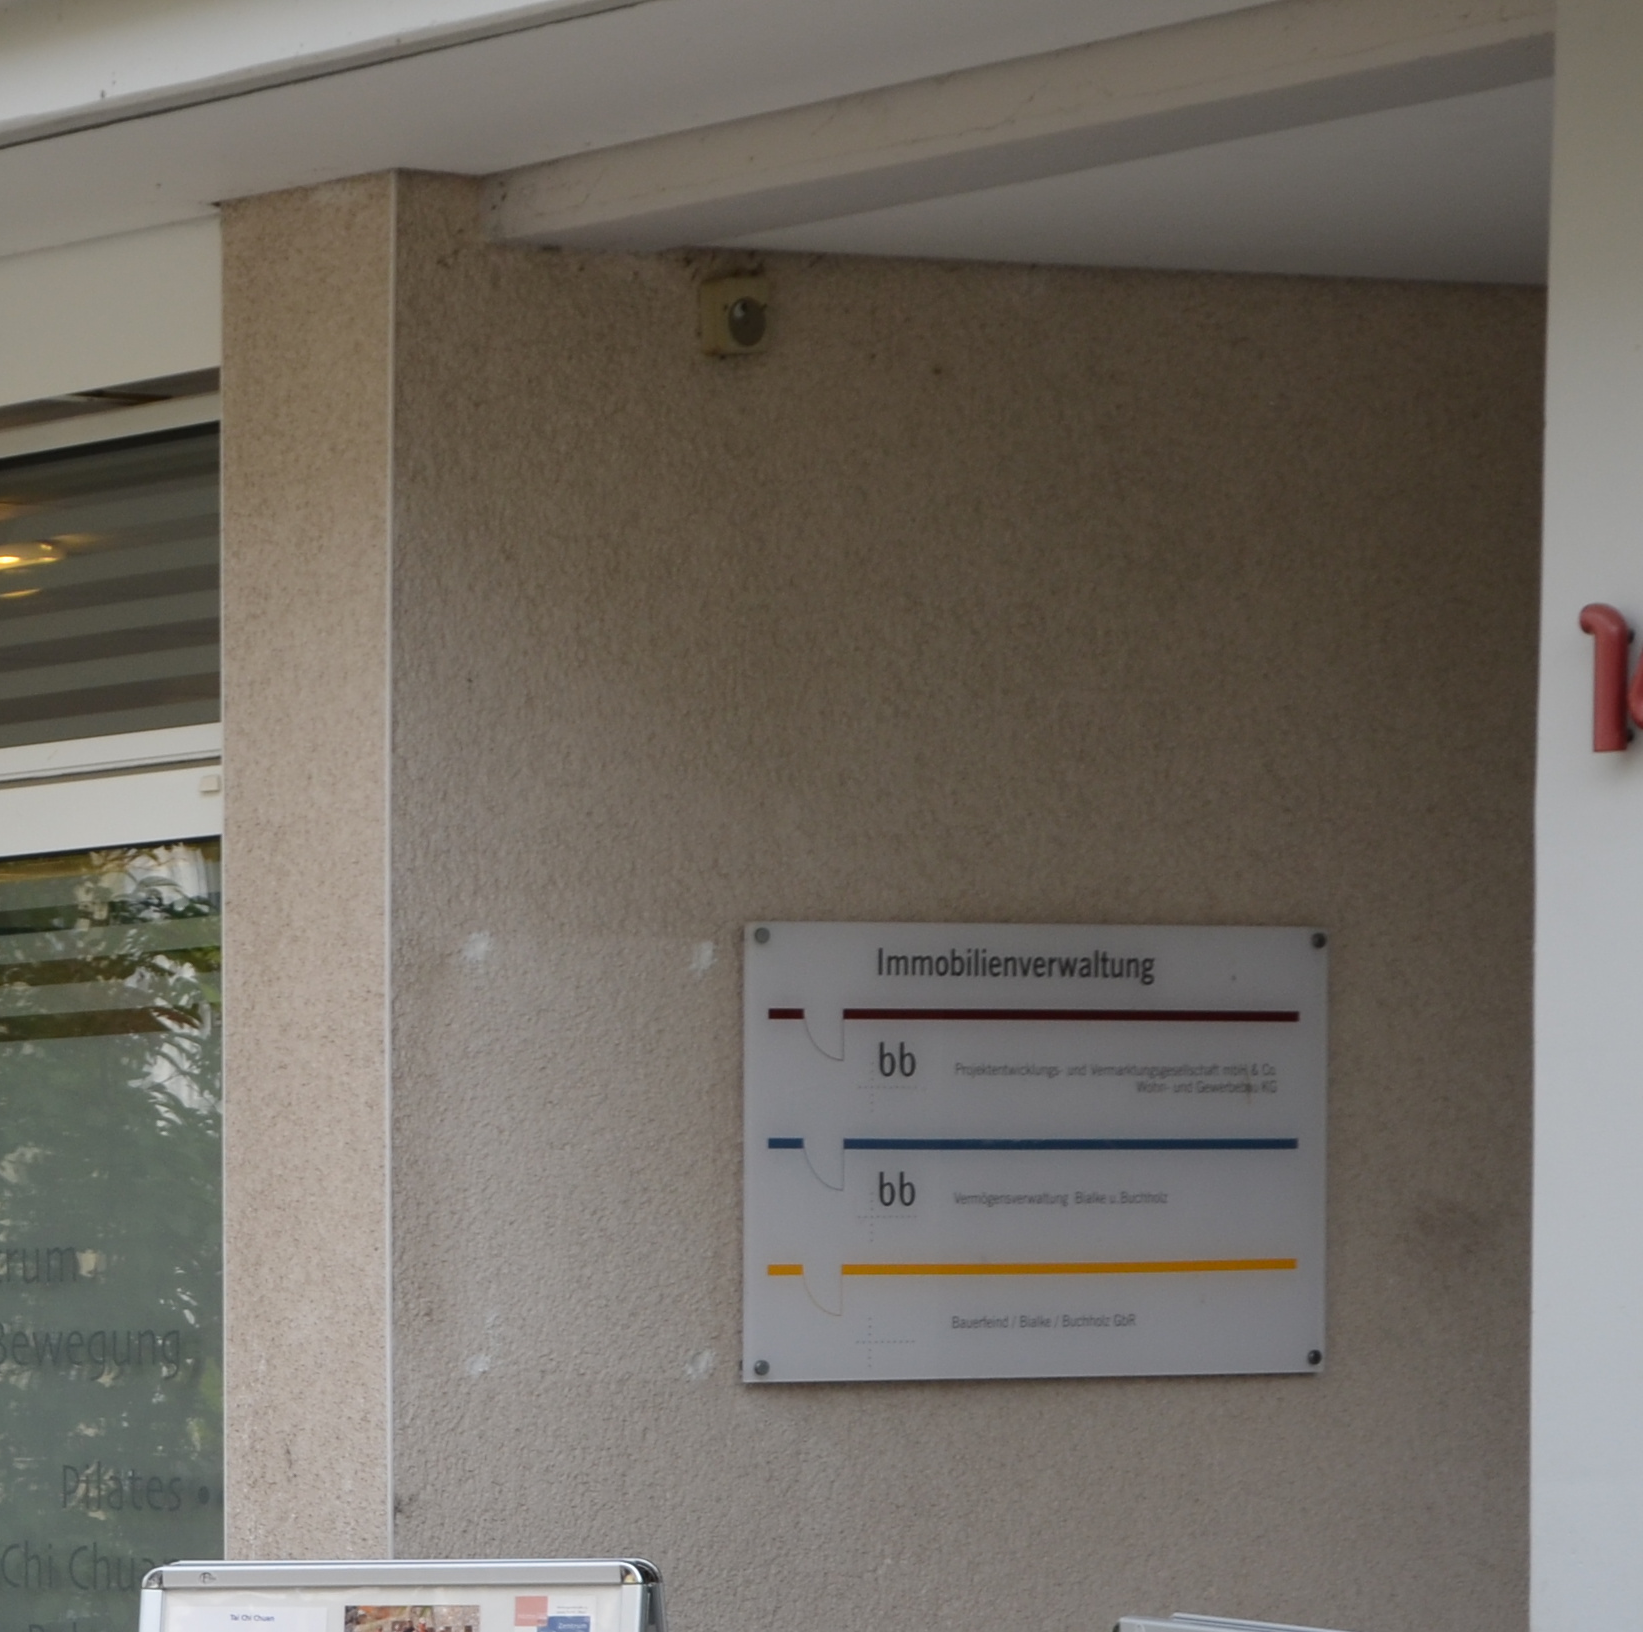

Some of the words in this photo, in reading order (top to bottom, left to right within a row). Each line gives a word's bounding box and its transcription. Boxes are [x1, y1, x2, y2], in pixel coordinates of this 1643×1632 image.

[1579, 603, 1643, 752] 1
[877, 947, 1155, 985] Immobilienverwaltung
[878, 1041, 916, 1077] bb
[878, 1171, 916, 1207] bb
[951, 1315, 1009, 1329] Bauerfeind
[1019, 1315, 1051, 1328] Bialke
[1062, 1314, 1110, 1328] Buchholz
[1114, 1314, 1137, 1327] GbR
[61, 1461, 183, 1512] Pilates
[0, 1540, 53, 1588] Chi
[68, 1542, 180, 1592] Chua
